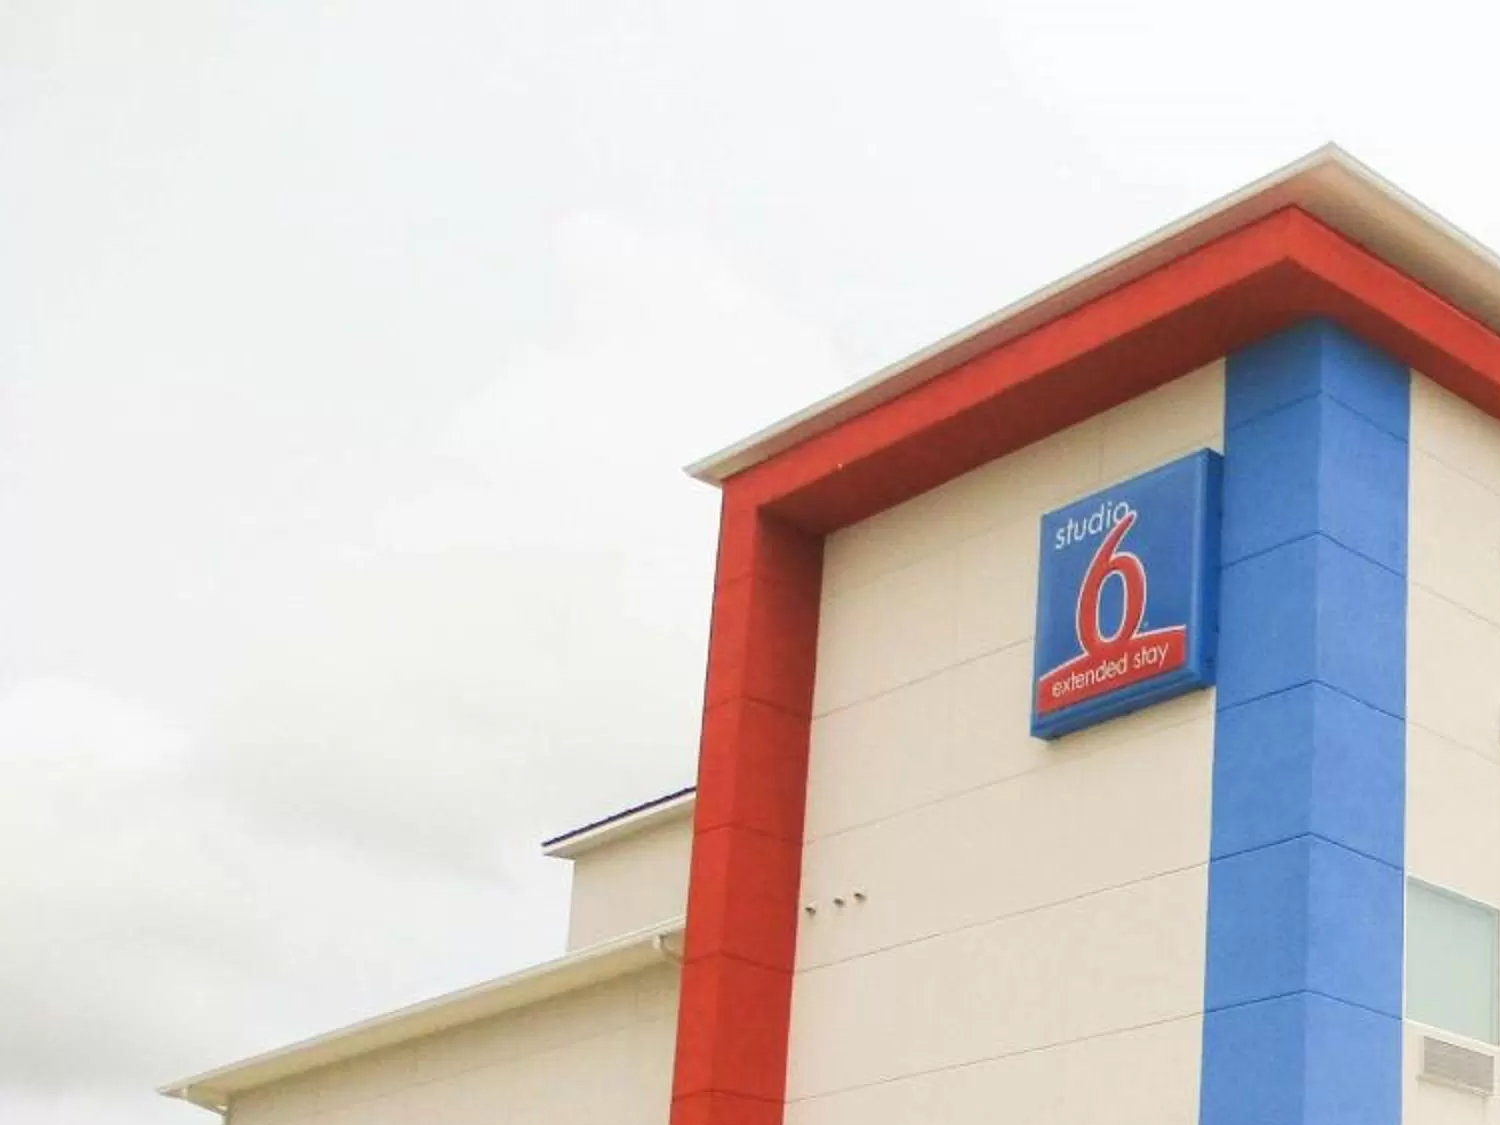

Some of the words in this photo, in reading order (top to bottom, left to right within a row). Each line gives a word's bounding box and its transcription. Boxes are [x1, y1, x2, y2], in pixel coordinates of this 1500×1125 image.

[1055, 500, 1130, 549] studio
[1076, 510, 1148, 655] 6
[1051, 655, 1129, 698] extended
[1132, 642, 1169, 668] stay
